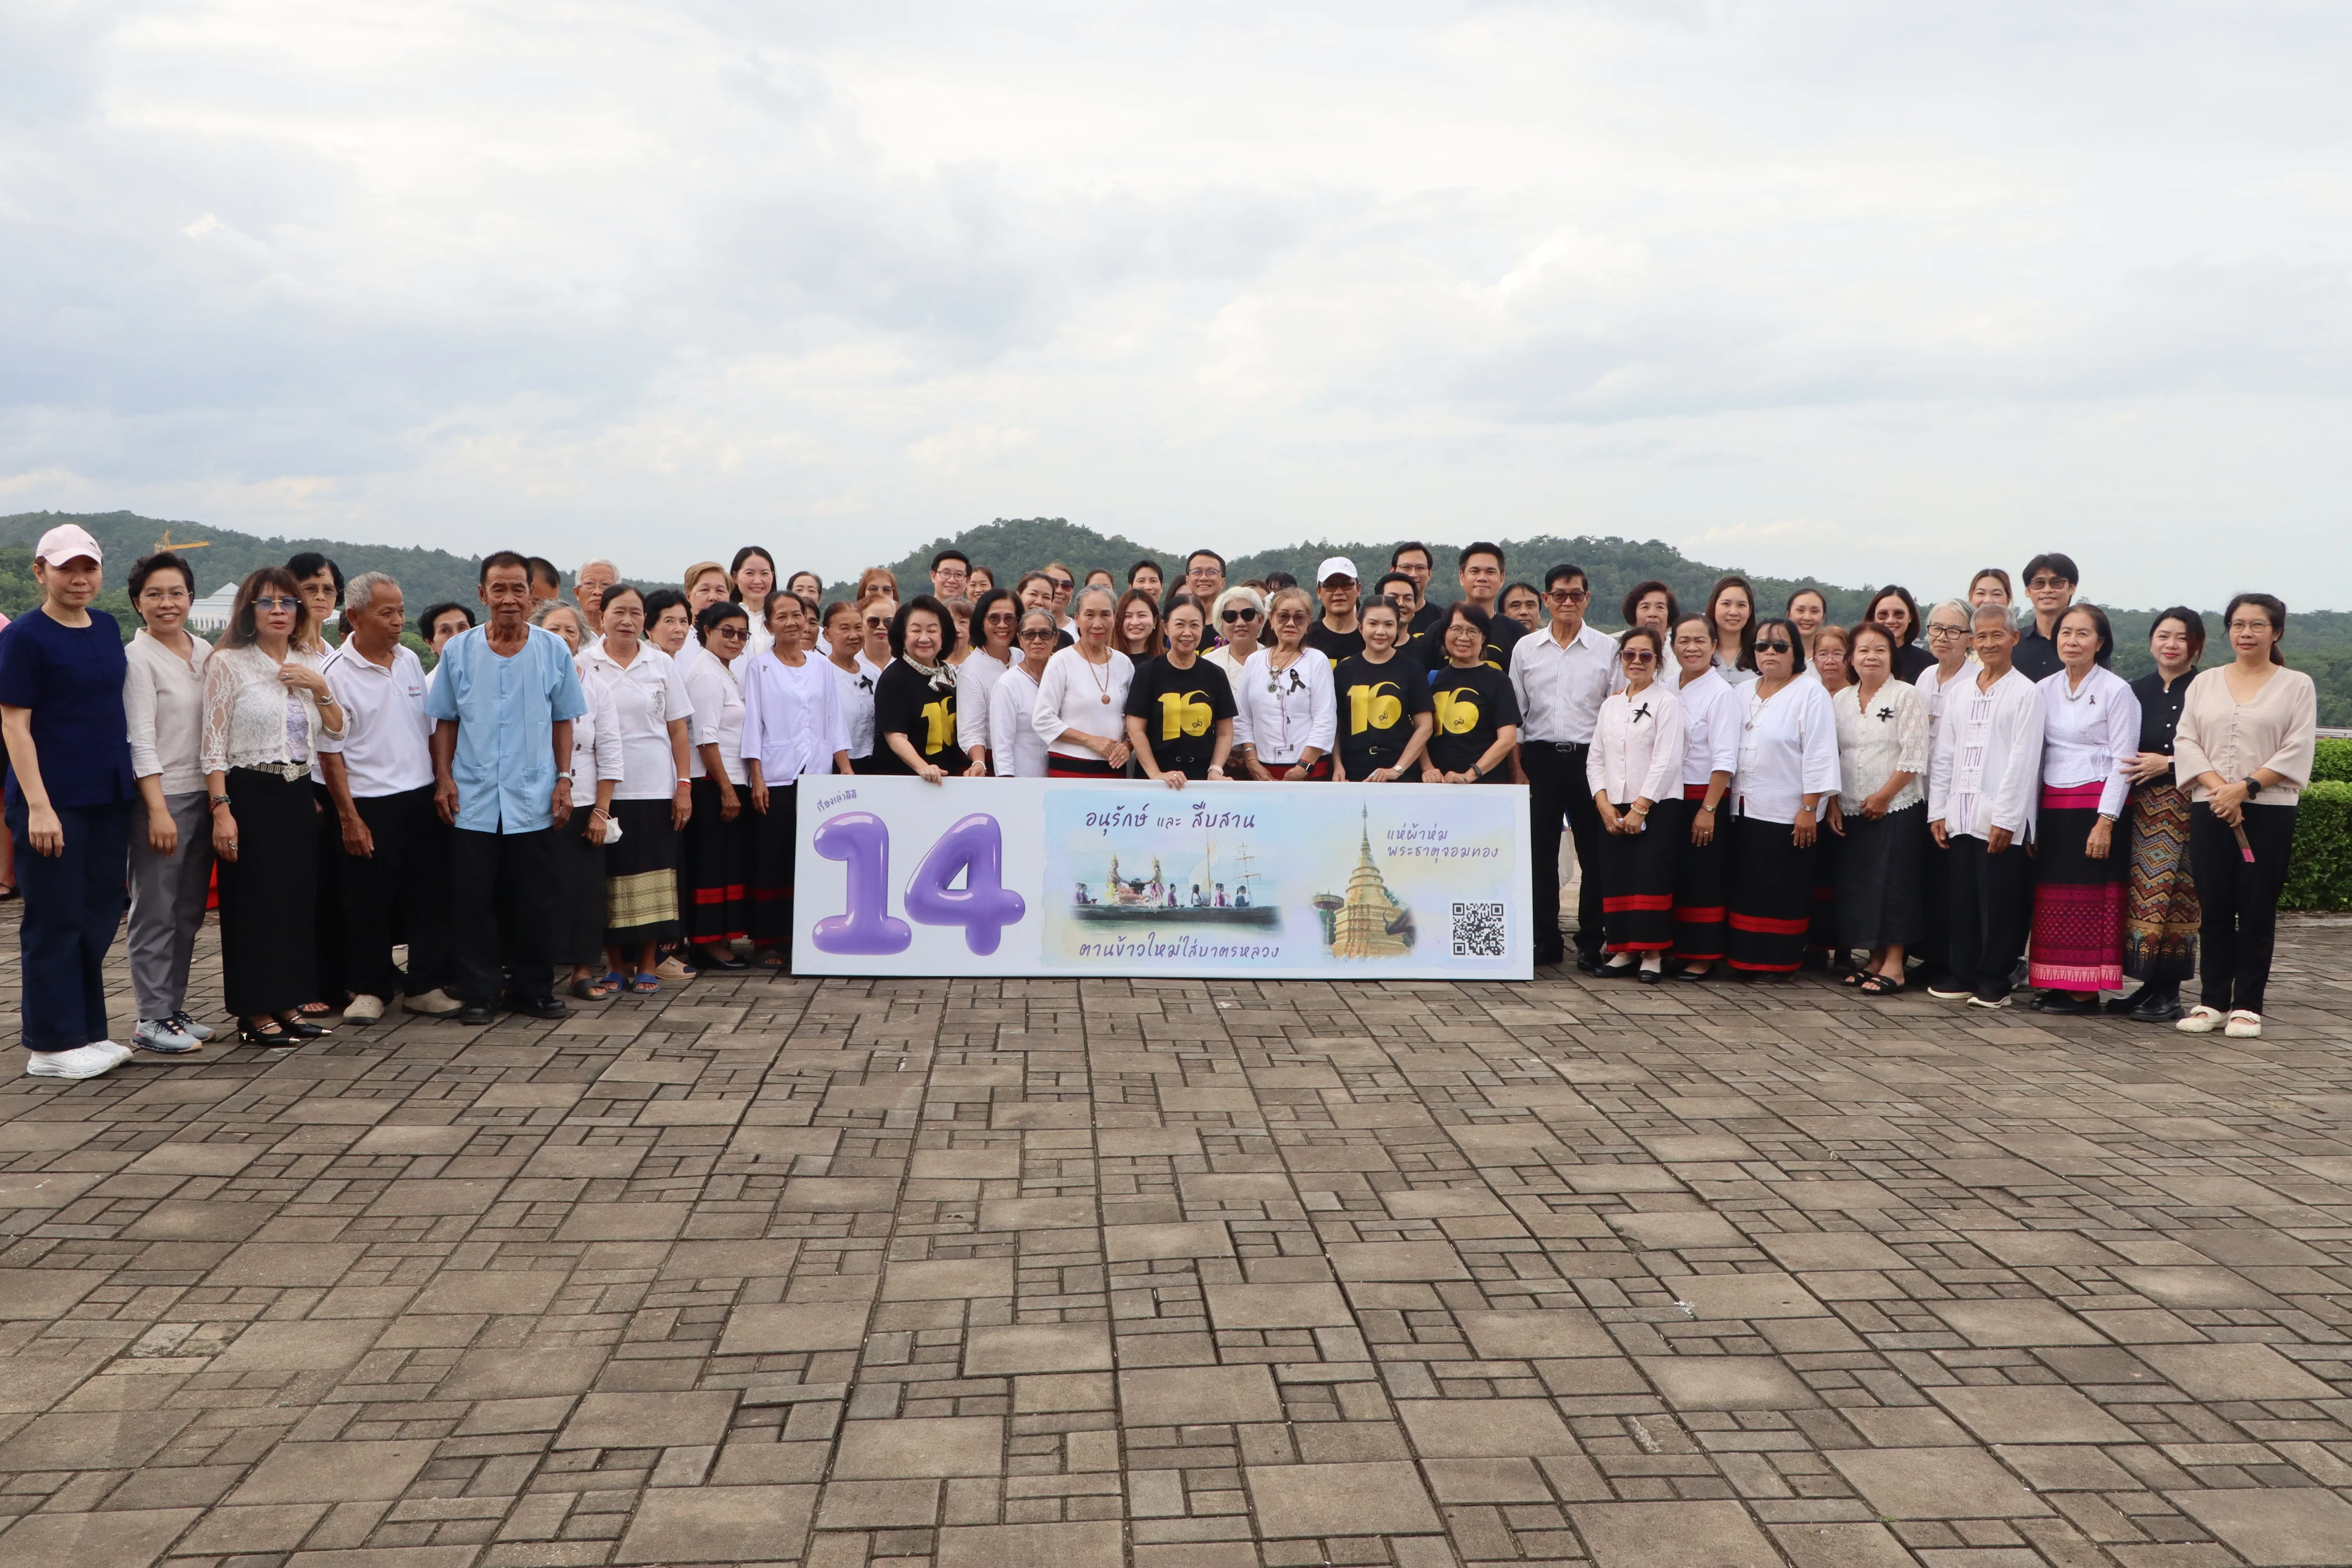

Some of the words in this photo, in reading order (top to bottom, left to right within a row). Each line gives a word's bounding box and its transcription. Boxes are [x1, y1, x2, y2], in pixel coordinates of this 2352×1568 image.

[1158, 690, 1213, 741] 16
[1347, 681, 1402, 735] 16
[1433, 687, 1479, 737] 16
[1085, 803, 1150, 837] อนุรักษ์
[1157, 817, 1181, 829] และ
[1191, 800, 1255, 829] สืบสาน
[1387, 823, 1448, 841] แห่ผ้าห่ม
[1387, 846, 1499, 864] พระธาตุจอมทอง
[812, 811, 1025, 956] 14
[1079, 932, 1280, 960] ตานข้าวใหม่ใส่บาตรหลวง
